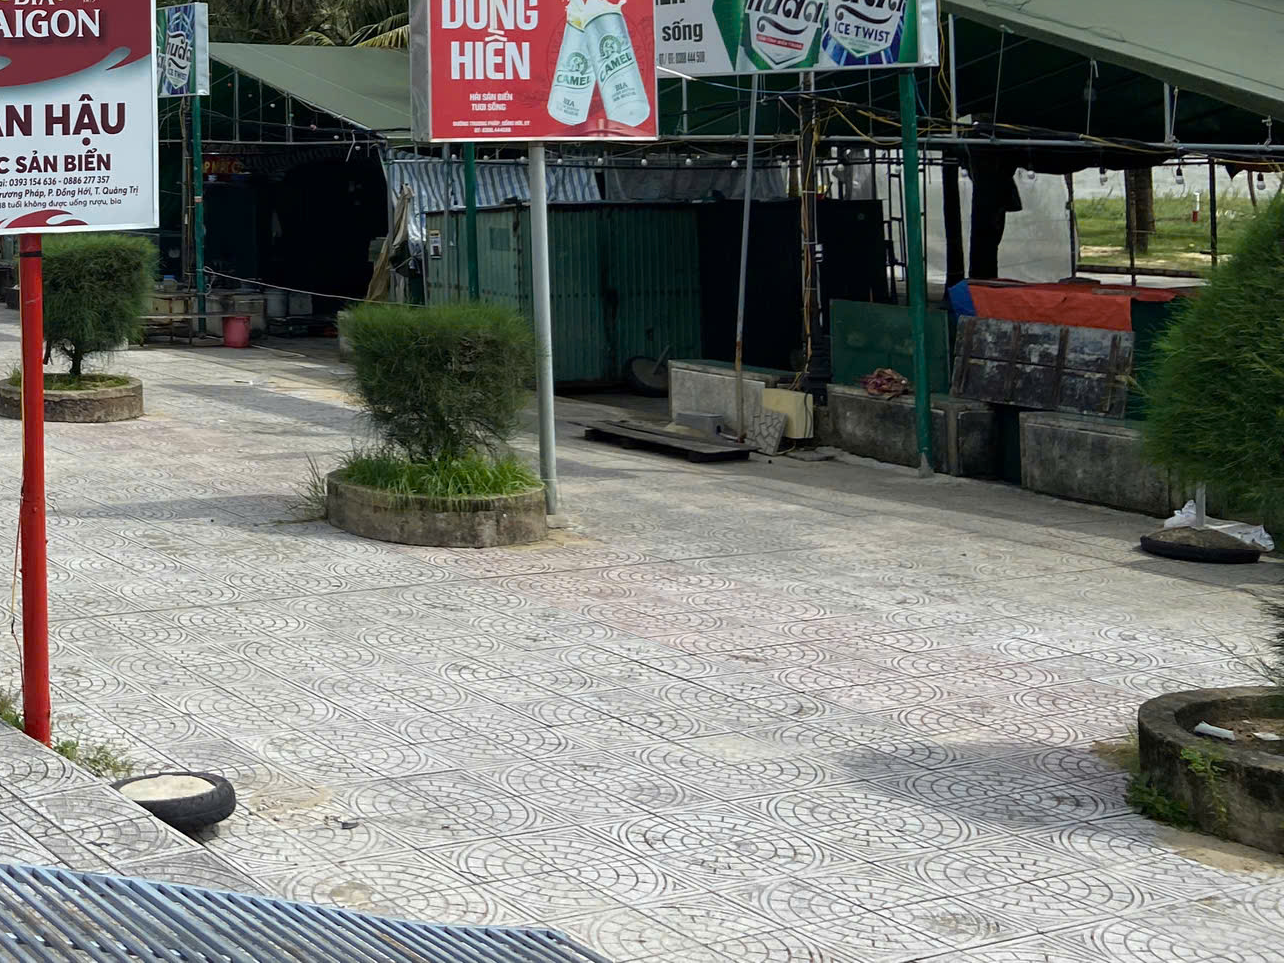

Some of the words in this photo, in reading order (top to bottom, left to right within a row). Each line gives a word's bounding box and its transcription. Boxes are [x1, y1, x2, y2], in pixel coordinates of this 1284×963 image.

[662, 18, 703, 42] sống
[834, 21, 851, 36] ICE
[854, 25, 891, 43] TWIST
[450, 28, 531, 80] HIỀN
[600, 52, 633, 83] CAMEL
[556, 74, 592, 86] CAMEL
[44, 93, 126, 146] HẬU
[15, 149, 58, 174] SẢN
[63, 148, 111, 173] BIỂN
[9, 178, 28, 187] 0393
[29, 177, 42, 186] 154
[43, 177, 57, 186] 636
[63, 176, 82, 185] 0886
[83, 176, 96, 184] 277
[97, 175, 111, 184] 357
[47, 188, 55, 197] P.
[95, 187, 101, 195] T.
